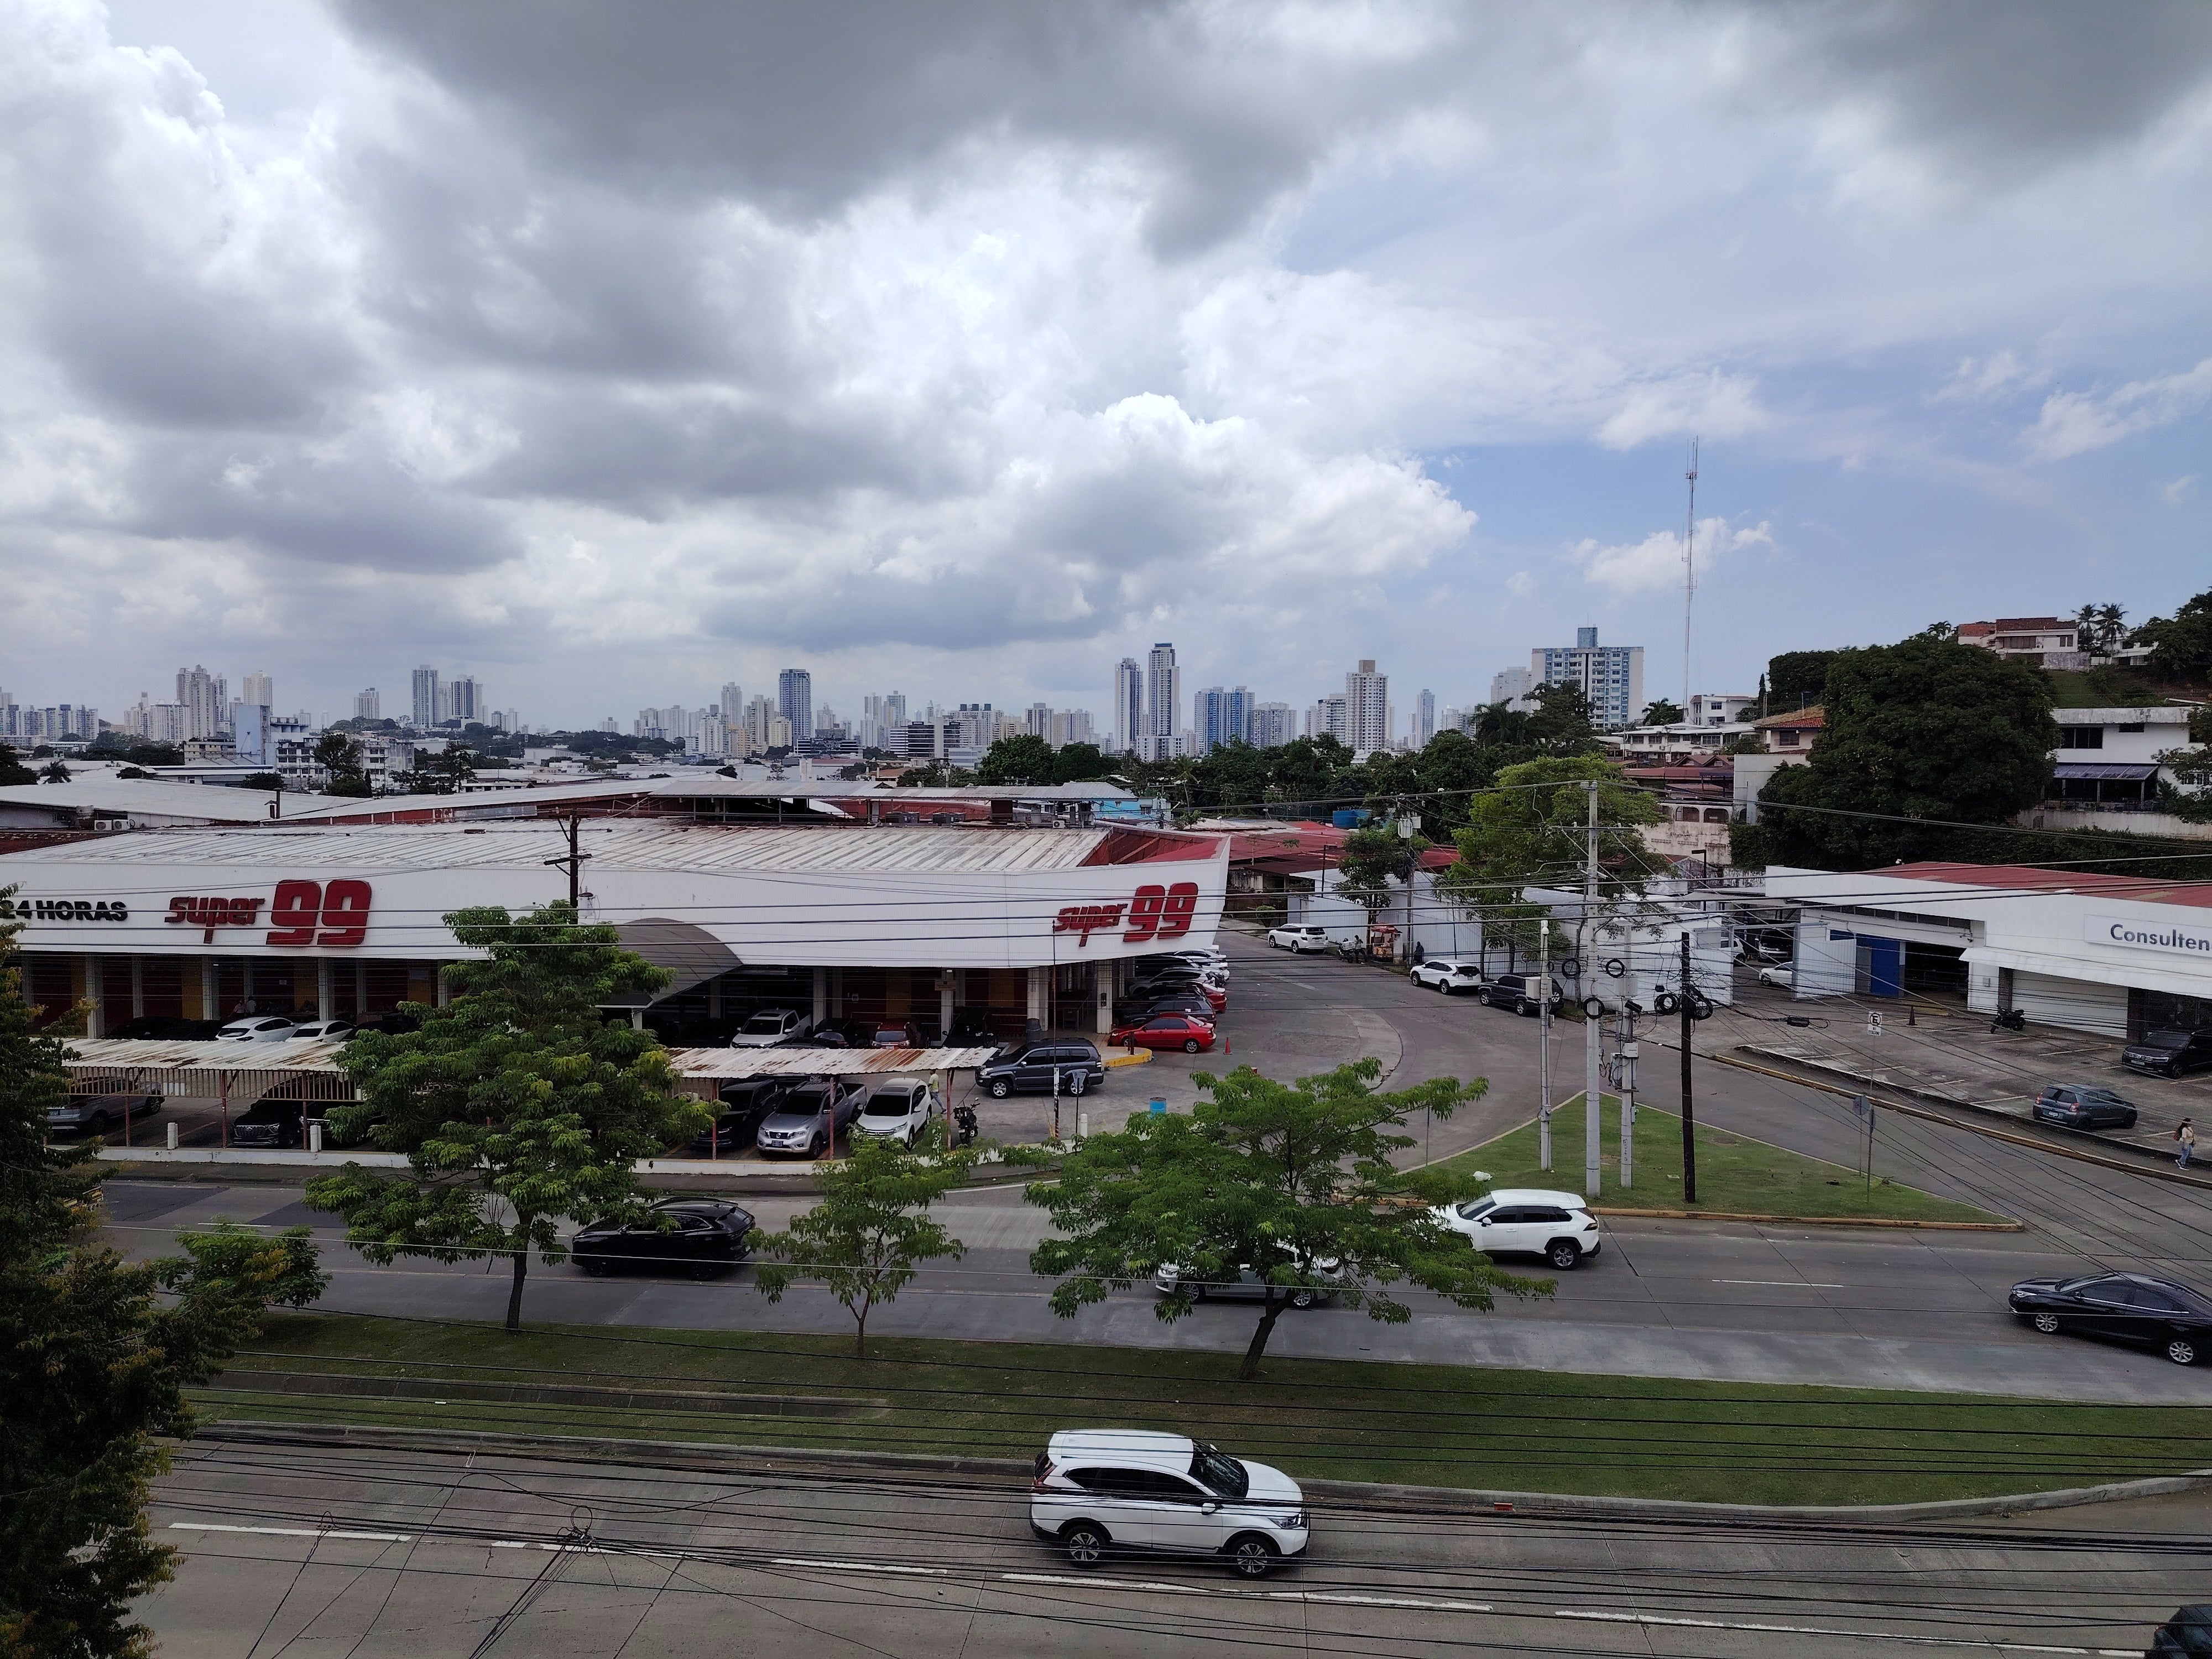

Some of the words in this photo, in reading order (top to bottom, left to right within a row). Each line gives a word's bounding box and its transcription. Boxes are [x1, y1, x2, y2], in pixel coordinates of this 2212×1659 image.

[35, 900, 128, 921] HORAS
[265, 879, 372, 946] 99
[1123, 882, 1198, 942] 99
